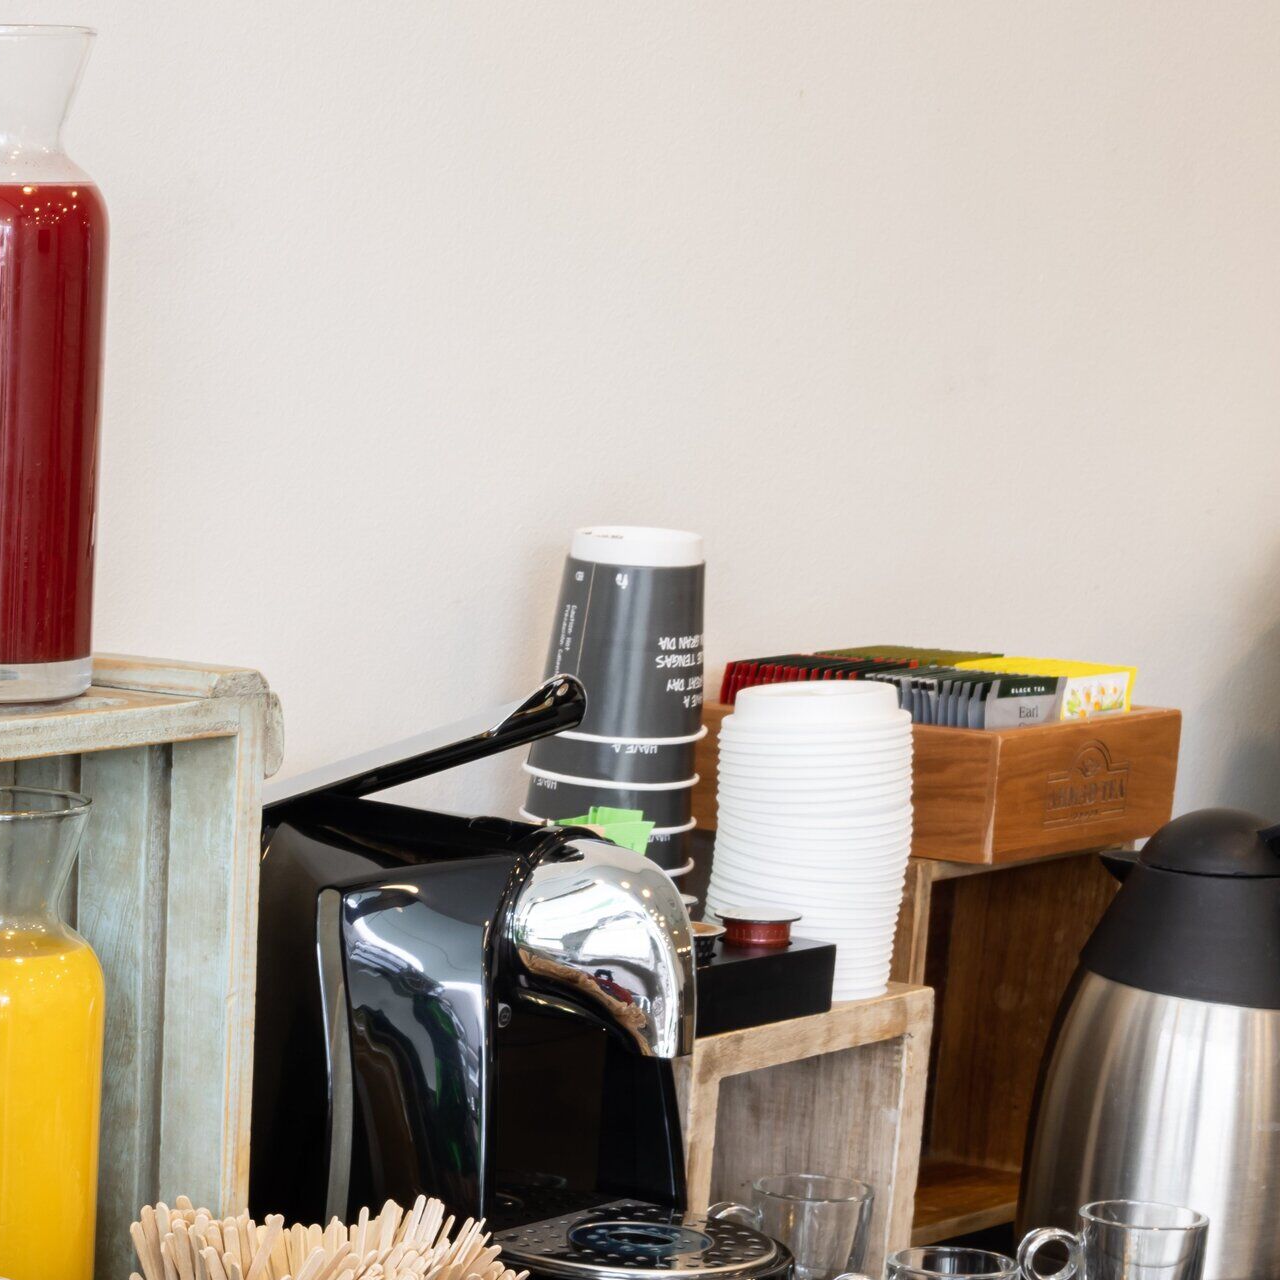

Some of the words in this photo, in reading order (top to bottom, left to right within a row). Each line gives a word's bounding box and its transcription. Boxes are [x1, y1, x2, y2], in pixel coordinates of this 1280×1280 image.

[655, 654, 697, 668] TENGAS
[666, 679, 685, 692] DAY
[1019, 706, 1039, 718] Earl
